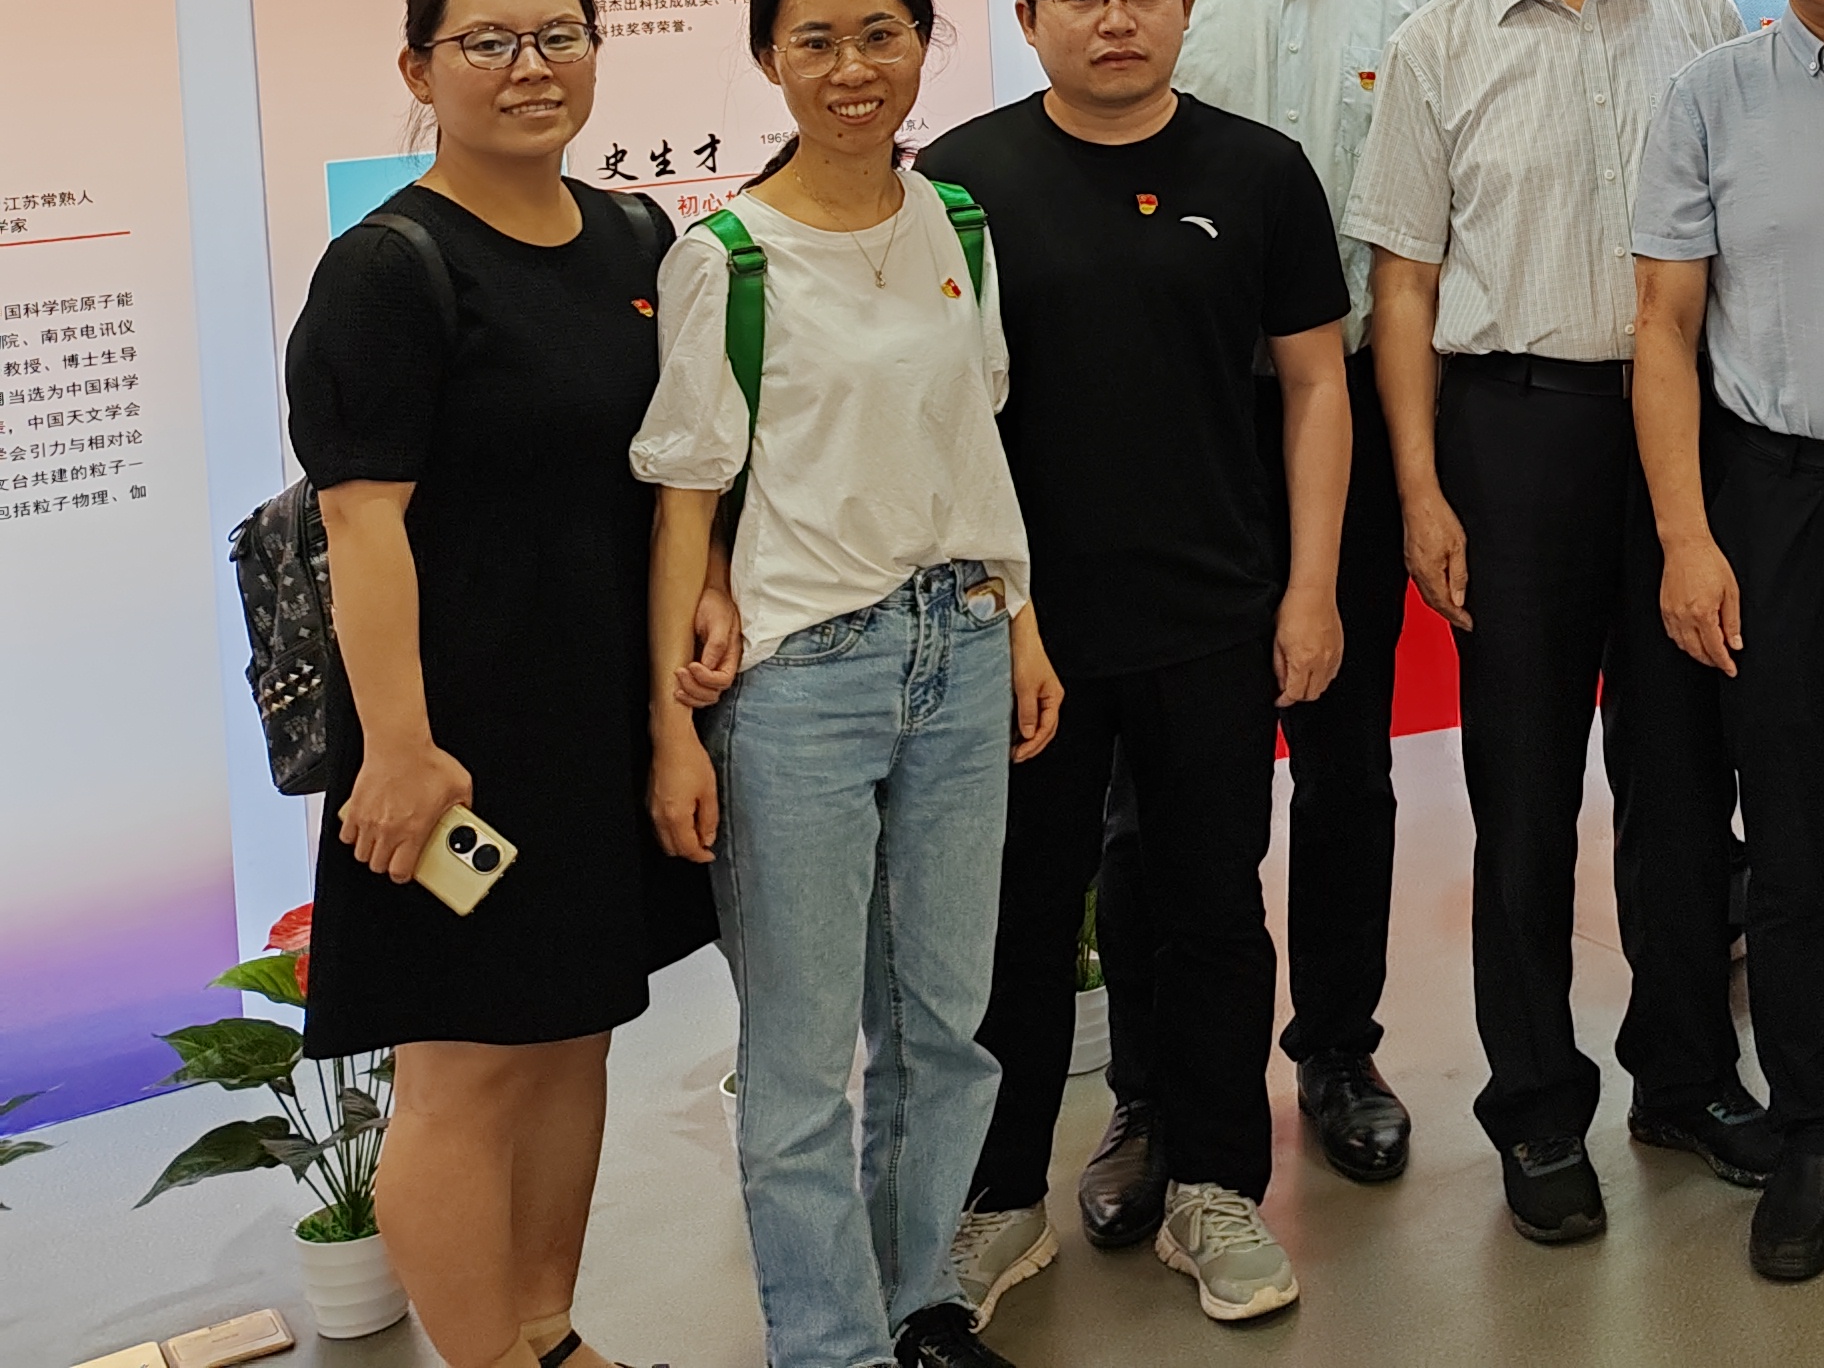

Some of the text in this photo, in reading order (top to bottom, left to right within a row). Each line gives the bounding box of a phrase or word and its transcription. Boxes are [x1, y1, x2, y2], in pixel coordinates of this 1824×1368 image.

[902, 117, 929, 132] 京人
[4, 189, 94, 212] 江苏常熟人
[0, 291, 134, 320] 国科学院原子能
[0, 319, 136, 350] 院、南京电讯仪
